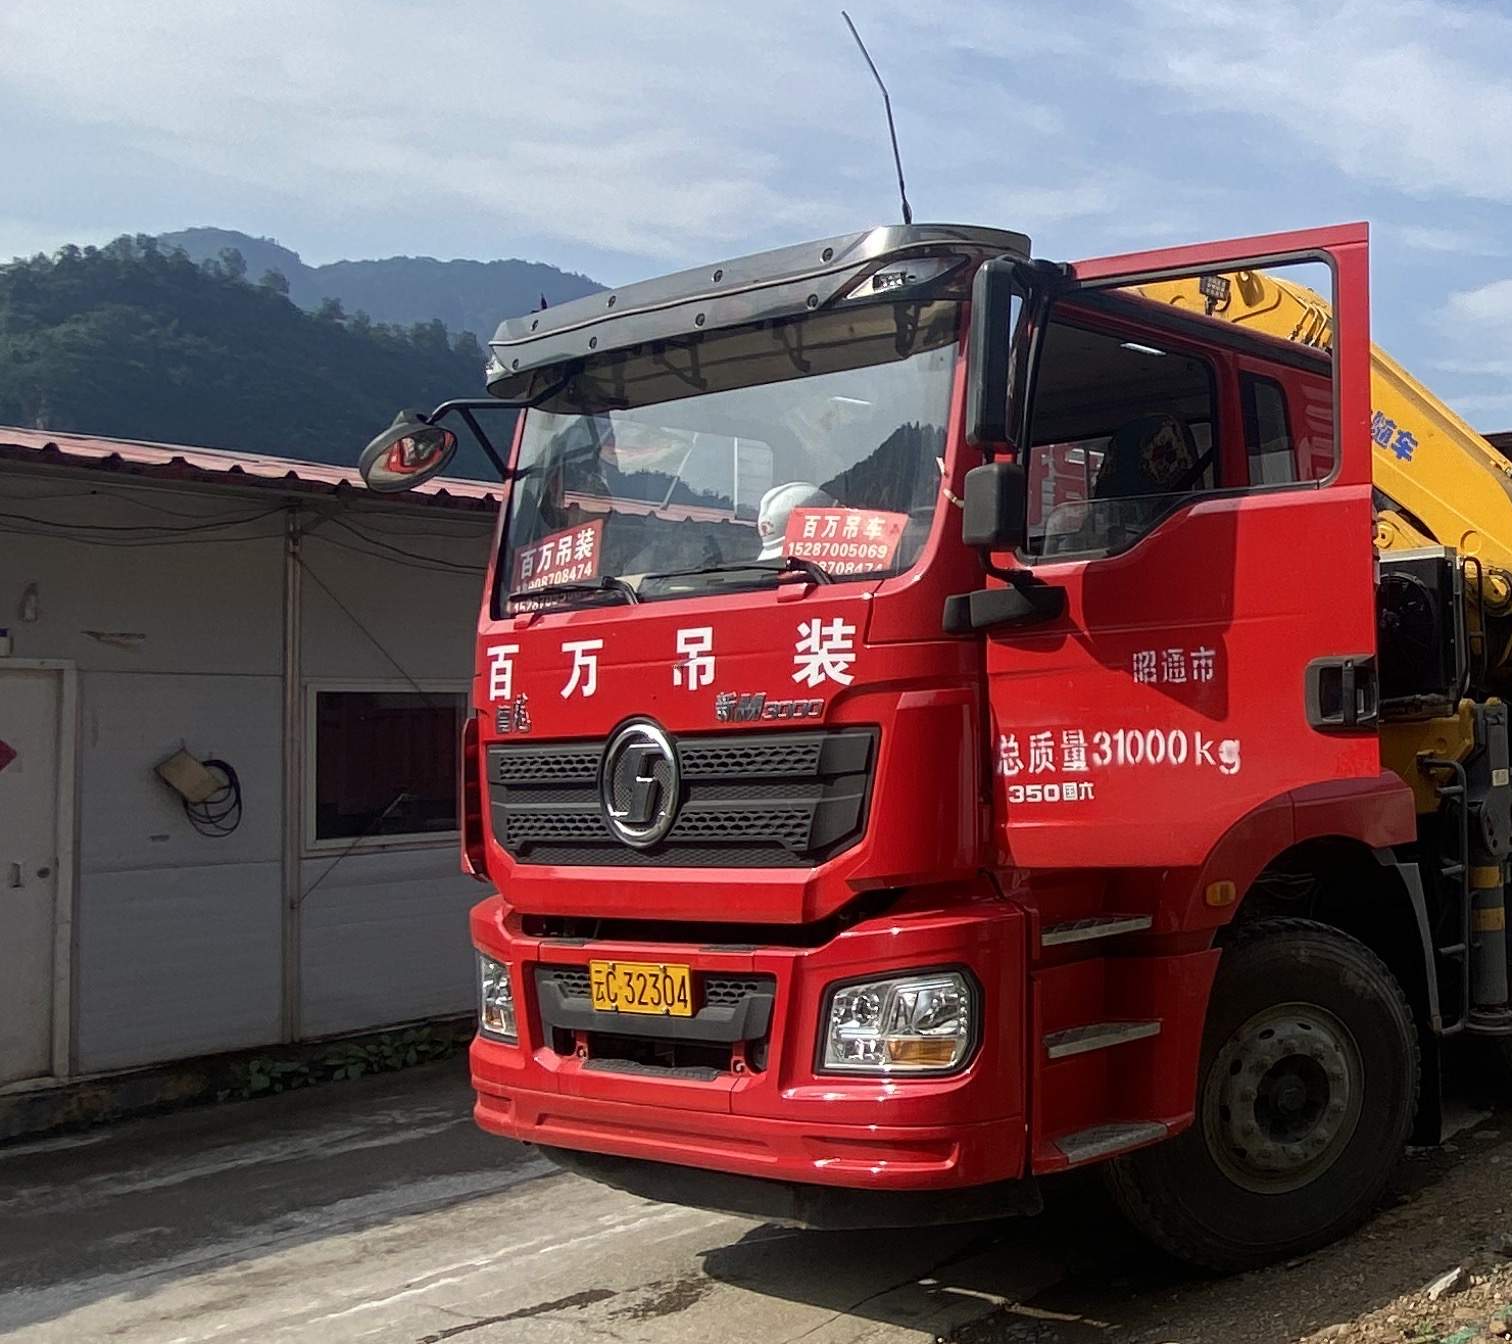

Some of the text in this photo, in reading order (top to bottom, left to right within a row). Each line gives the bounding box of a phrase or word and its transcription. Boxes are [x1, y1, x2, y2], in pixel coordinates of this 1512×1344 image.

[803, 515, 885, 540] 百万吊车
[520, 527, 595, 579] 百万吊装
[788, 541, 888, 559] 15287005069
[487, 617, 857, 701] 百万吊装
[1132, 647, 1216, 683] 昭通市
[1008, 782, 1095, 803] 350国六
